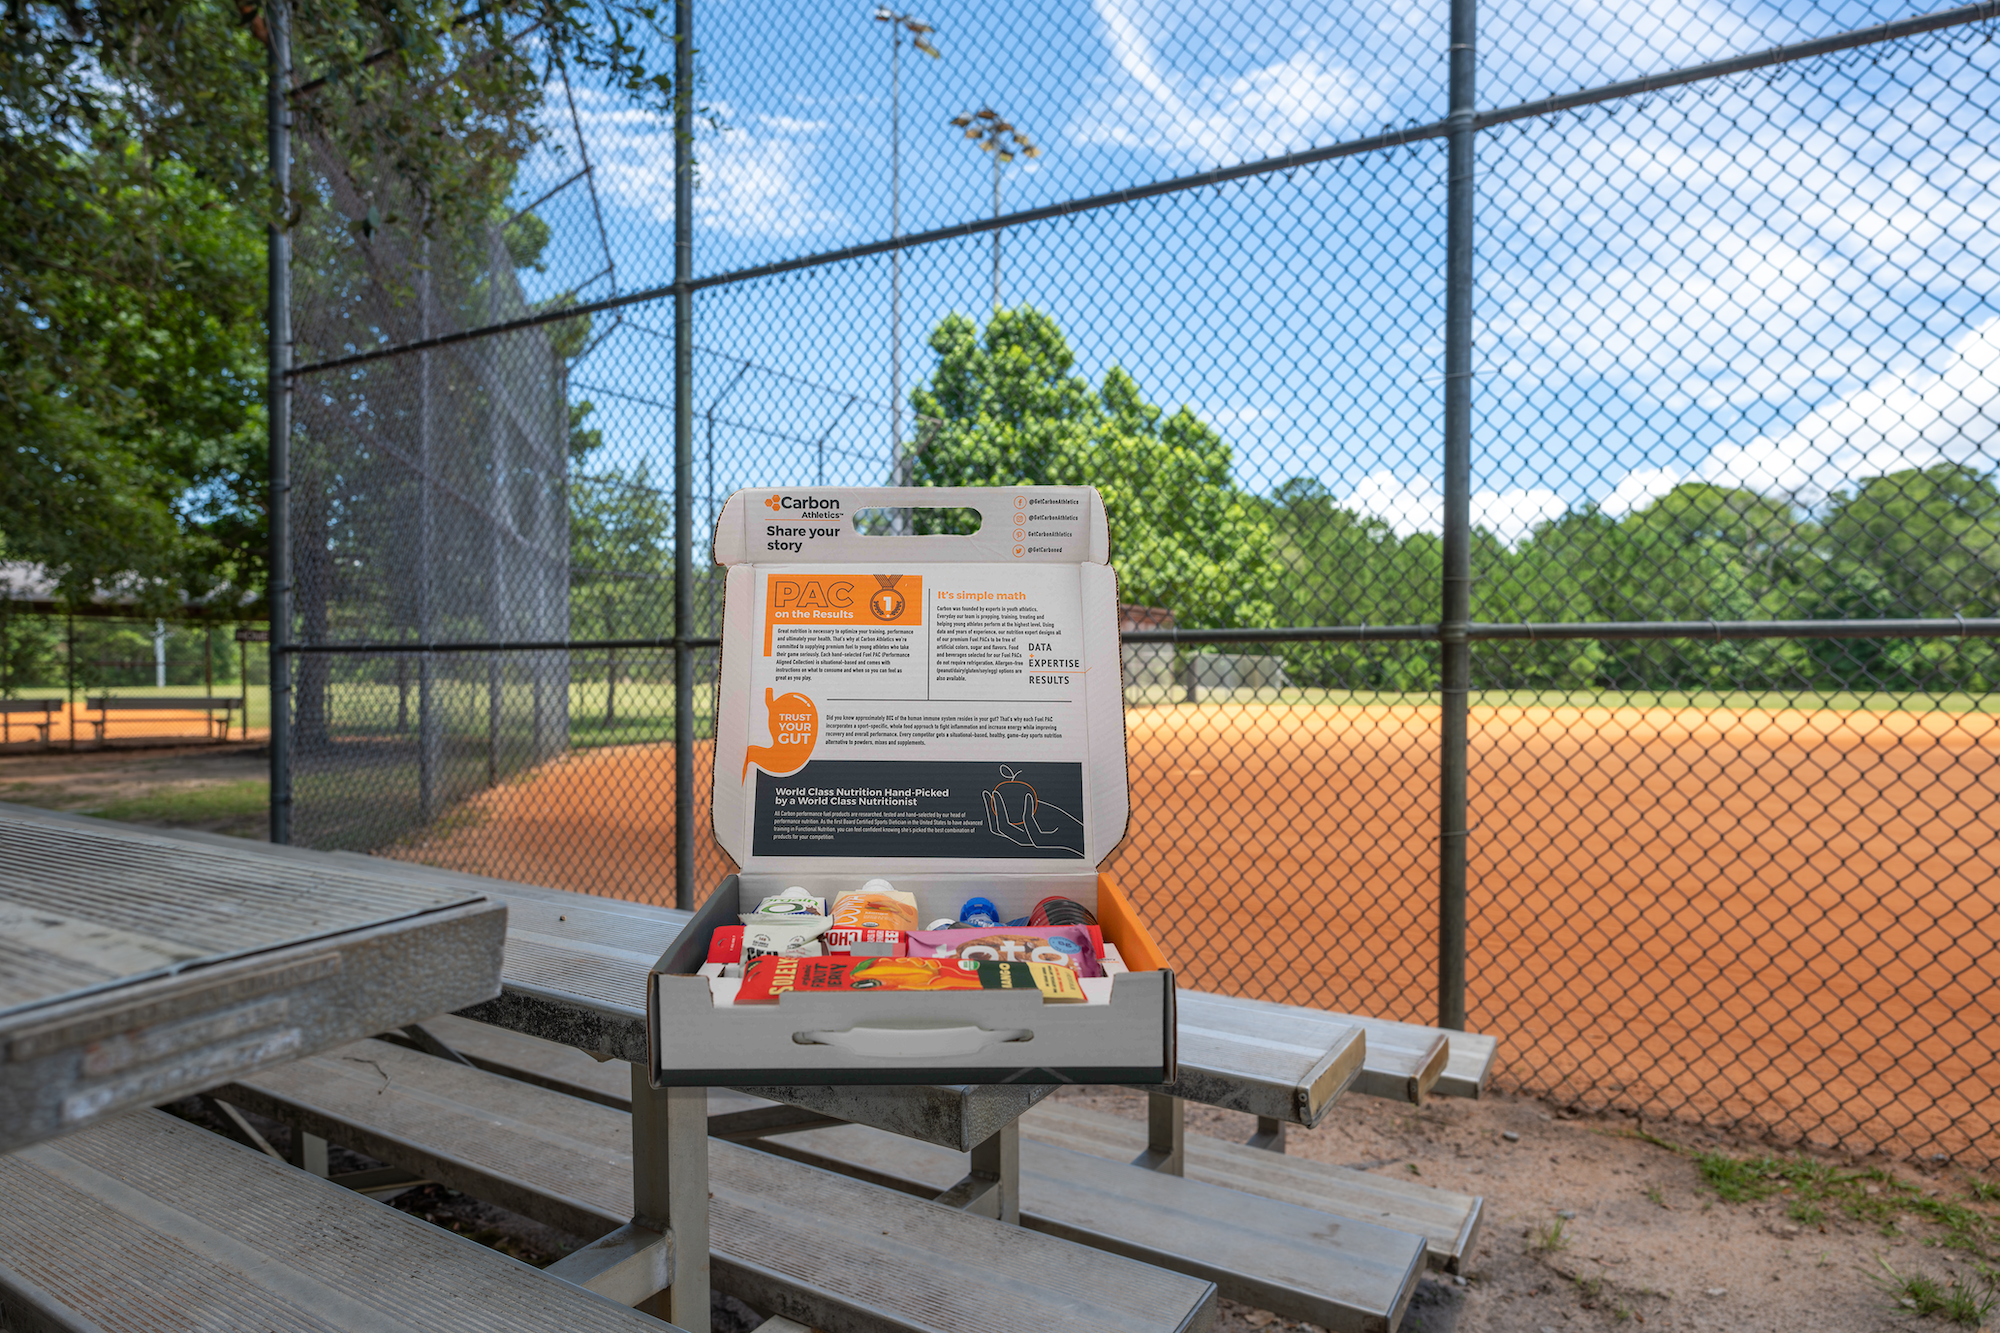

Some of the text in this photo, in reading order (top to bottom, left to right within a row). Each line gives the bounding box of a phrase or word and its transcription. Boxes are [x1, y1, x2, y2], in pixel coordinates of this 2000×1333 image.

[781, 496, 840, 509] Carbon
[766, 526, 840, 539] Share your
[767, 540, 802, 552] story
[774, 580, 854, 608] PAC
[938, 591, 1026, 601] It's simple math
[792, 610, 810, 618] the
[813, 610, 854, 619] Results
[1028, 643, 1052, 651] DATA
[1029, 659, 1080, 668] EXPERTISE
[1029, 676, 1070, 684] RESULTS
[779, 713, 812, 722] TRUST
[779, 723, 812, 732] YOUR
[778, 732, 811, 745] GUT
[775, 788, 949, 797] World Class Nutrition Hand-Picked
[775, 796, 787, 806] by
[798, 797, 828, 805] World
[858, 797, 917, 806] Nutritionist
[769, 958, 800, 996] SOLELY
[802, 964, 812, 986] organic
[811, 963, 828, 988] FRUIT
[828, 964, 848, 988] JERKY
